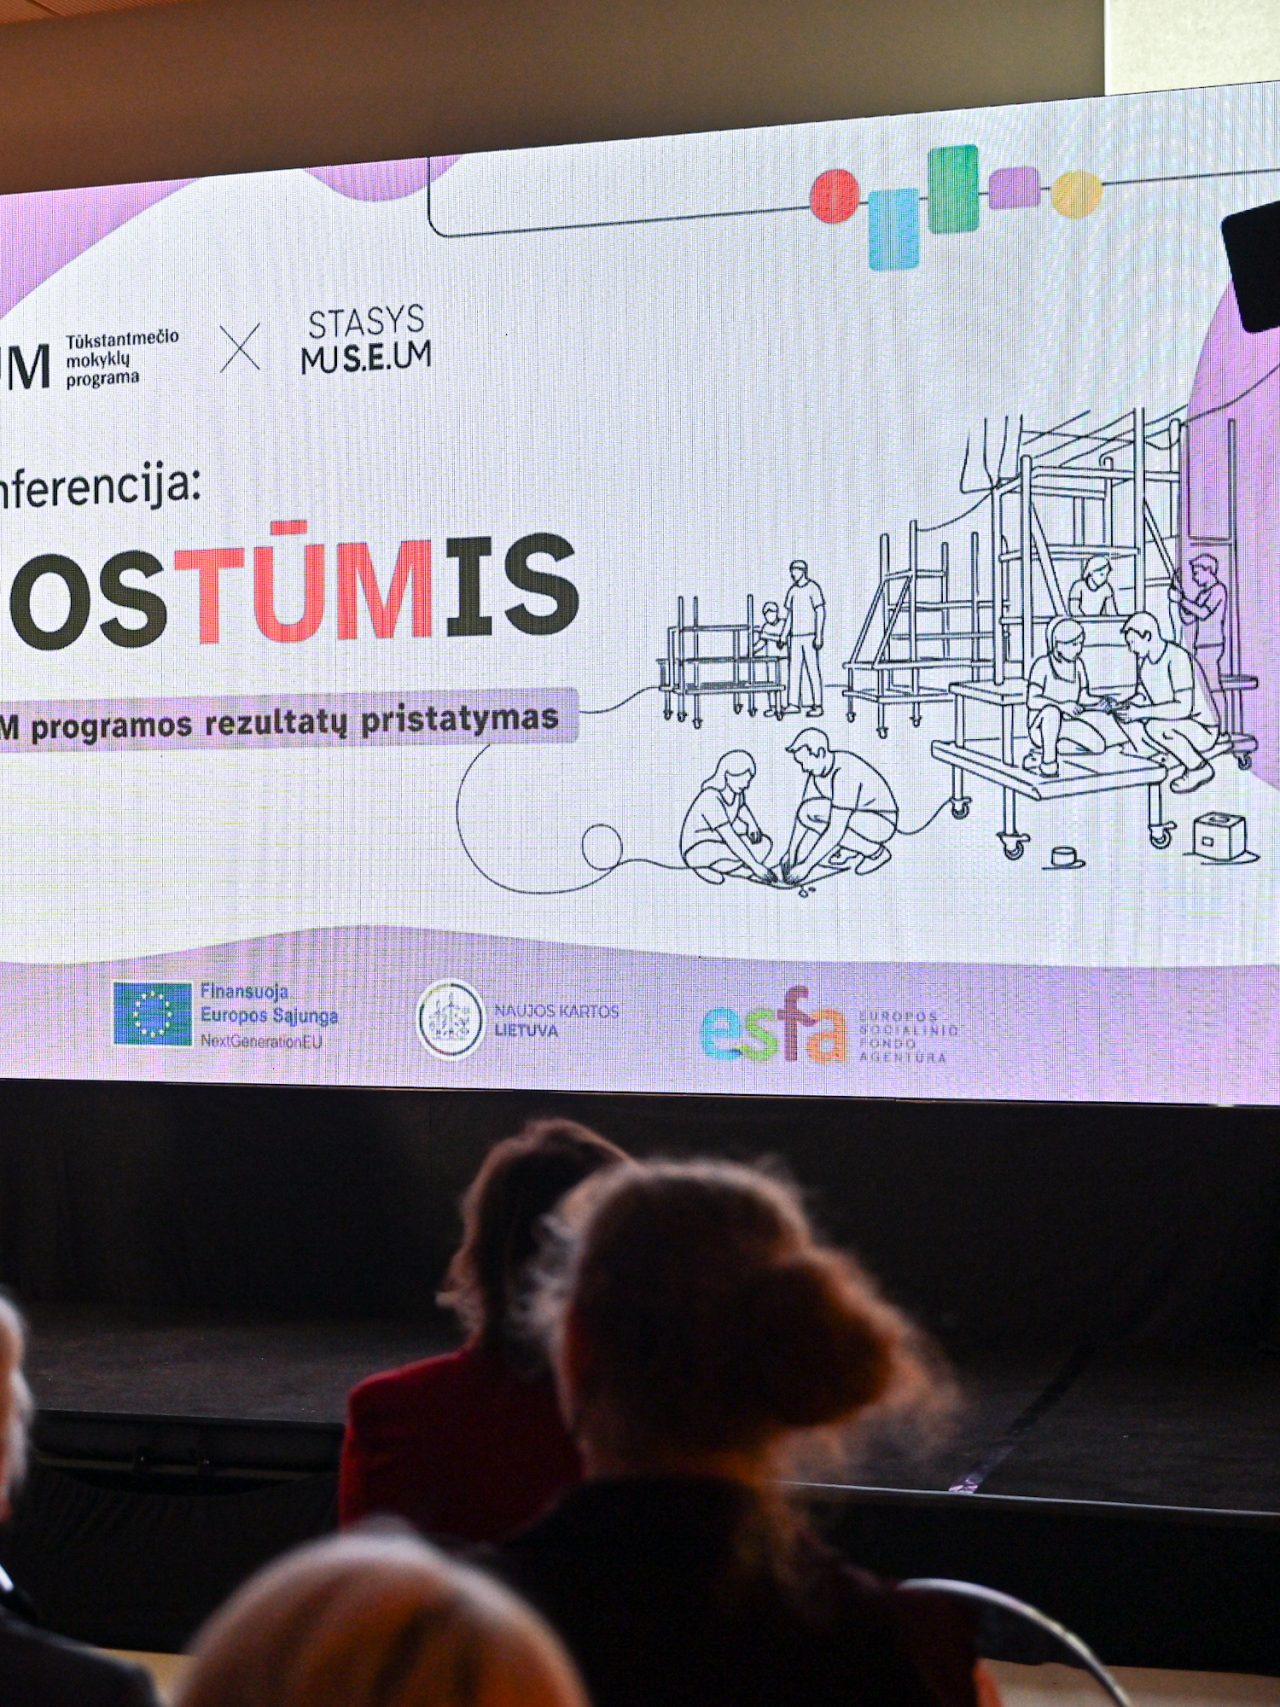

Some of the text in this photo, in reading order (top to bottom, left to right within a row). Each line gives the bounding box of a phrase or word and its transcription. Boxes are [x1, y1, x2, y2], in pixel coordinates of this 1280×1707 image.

[309, 303, 425, 339] STASYS
[66, 328, 180, 350] Tūkstantmečio
[66, 350, 130, 370] mokyklų
[66, 370, 140, 391] programa
[31, 714, 193, 745] programos
[205, 705, 348, 740] rezultatų
[361, 702, 560, 739] pristatymas
[200, 982, 289, 1005] Finansuoja
[200, 1006, 339, 1028] Europos Sąjunga
[494, 1003, 620, 1019] NAUJOS KARTOS
[859, 1010, 939, 1023] EUROPOS
[494, 1023, 559, 1038] LIETUVA
[699, 985, 849, 1064] esfa
[200, 1033, 324, 1050] NextGenerationEU
[859, 1038, 917, 1050] FONDO
